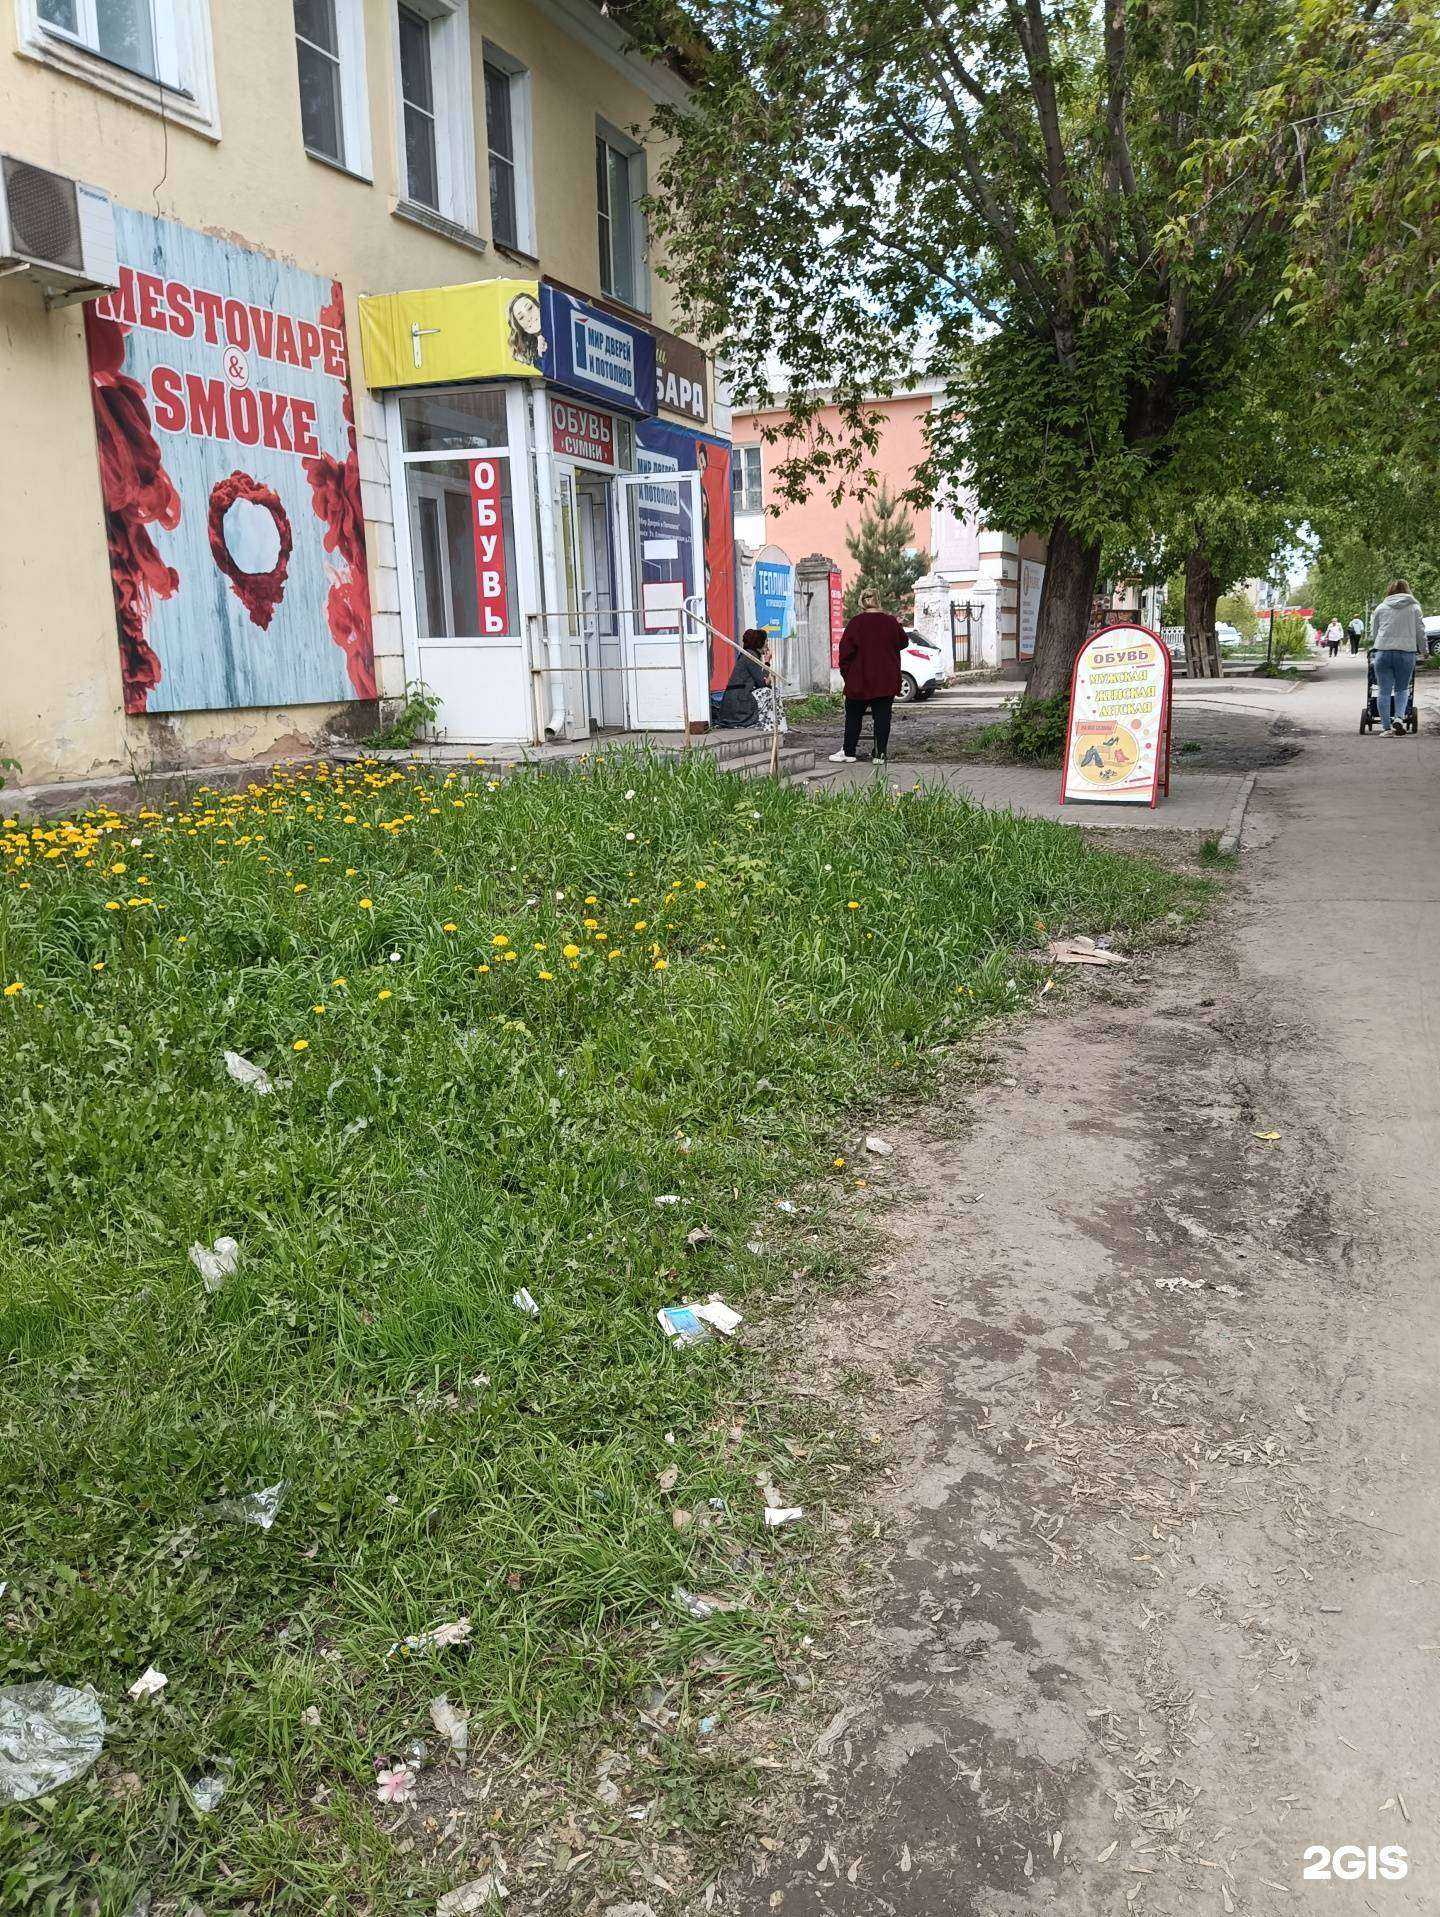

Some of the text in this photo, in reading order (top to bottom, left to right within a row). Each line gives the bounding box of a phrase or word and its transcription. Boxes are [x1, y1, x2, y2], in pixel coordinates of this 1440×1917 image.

[95, 265, 347, 380] MESTOVAPE
[587, 326, 604, 353] МИР
[604, 334, 632, 363] ДВЕРЕЙ
[228, 354, 245, 380] &
[588, 354, 632, 388] И ПОТОЛКОВ
[150, 365, 322, 458] SMOKE
[554, 403, 610, 443] ОБУВЬ
[564, 436, 603, 461] СУМКИ
[474, 462, 504, 633] ОБУВЬ
[1093, 650, 1149, 664] ОБУВЬ
[1089, 670, 1148, 685] МУЖСКАЯ
[1095, 686, 1156, 702] ЖЕНСКАЯ
[1099, 702, 1153, 718] ДЕТСКАЯ
